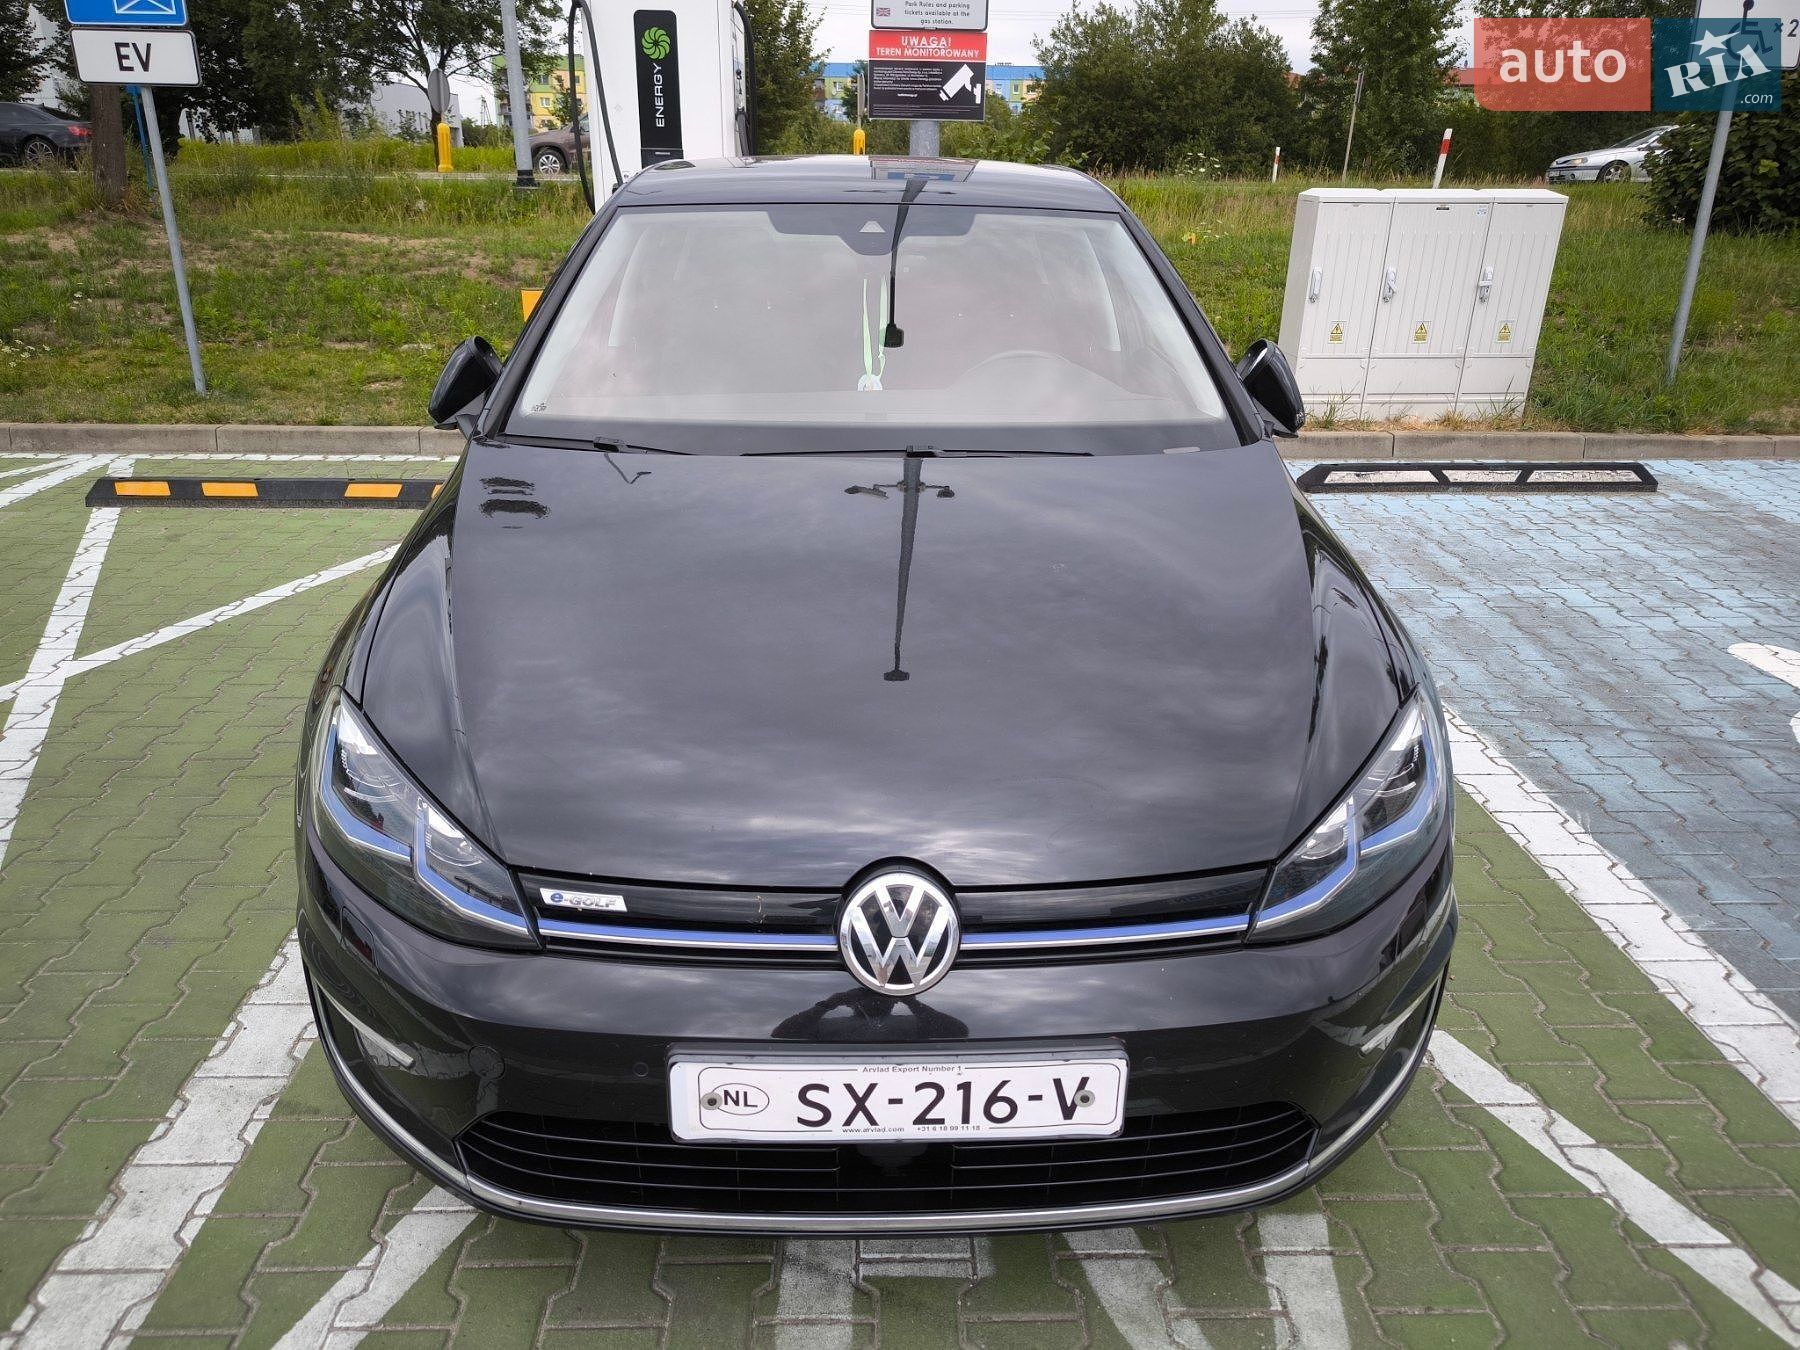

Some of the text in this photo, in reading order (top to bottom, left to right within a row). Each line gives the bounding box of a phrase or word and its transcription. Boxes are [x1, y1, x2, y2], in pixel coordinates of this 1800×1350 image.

[1787, 18, 1800, 37] 2
[901, 36, 952, 47] UWAGA!
[114, 42, 152, 72] EV
[876, 47, 980, 58] TEREN MONITOROWANY
[652, 62, 665, 128] ENERGY
[892, 1065, 920, 1074] Export
[722, 1089, 759, 1108] NL
[796, 1076, 1090, 1127] SX-216-V
